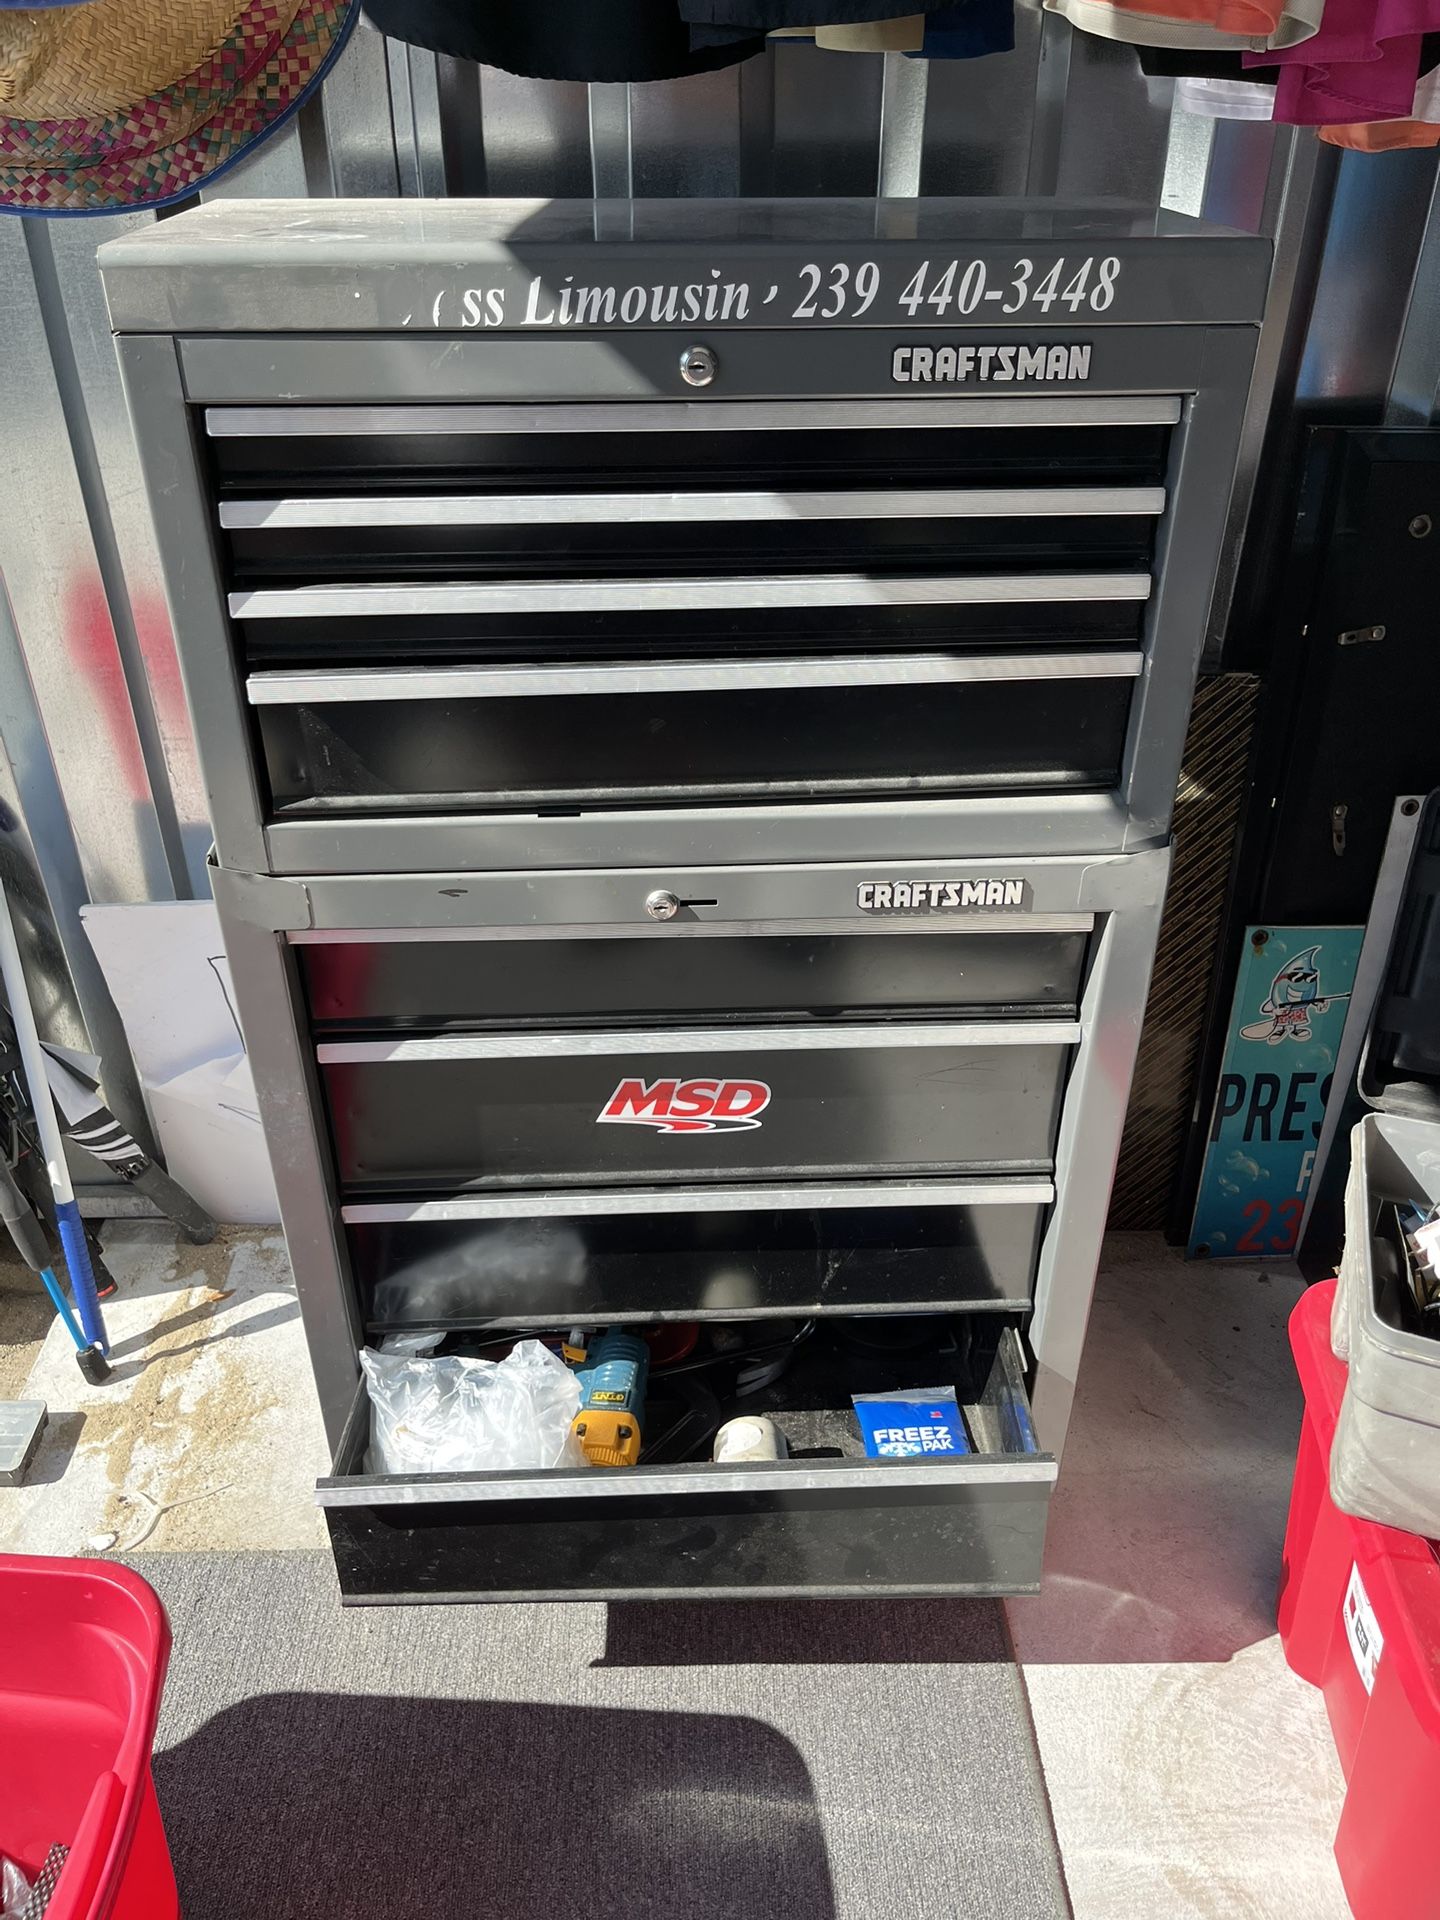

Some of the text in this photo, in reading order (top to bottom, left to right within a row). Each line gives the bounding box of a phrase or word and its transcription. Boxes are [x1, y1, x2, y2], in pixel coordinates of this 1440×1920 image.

[791, 262, 881, 319] 239
[898, 256, 1121, 317] 440-3448
[891, 343, 1093, 382] CRAFTSMAN
[857, 878, 1025, 910] CRAFTSMAN
[597, 1078, 771, 1124] MSD
[873, 1425, 952, 1444] FREEZ
[921, 1439, 955, 1452] PAK
